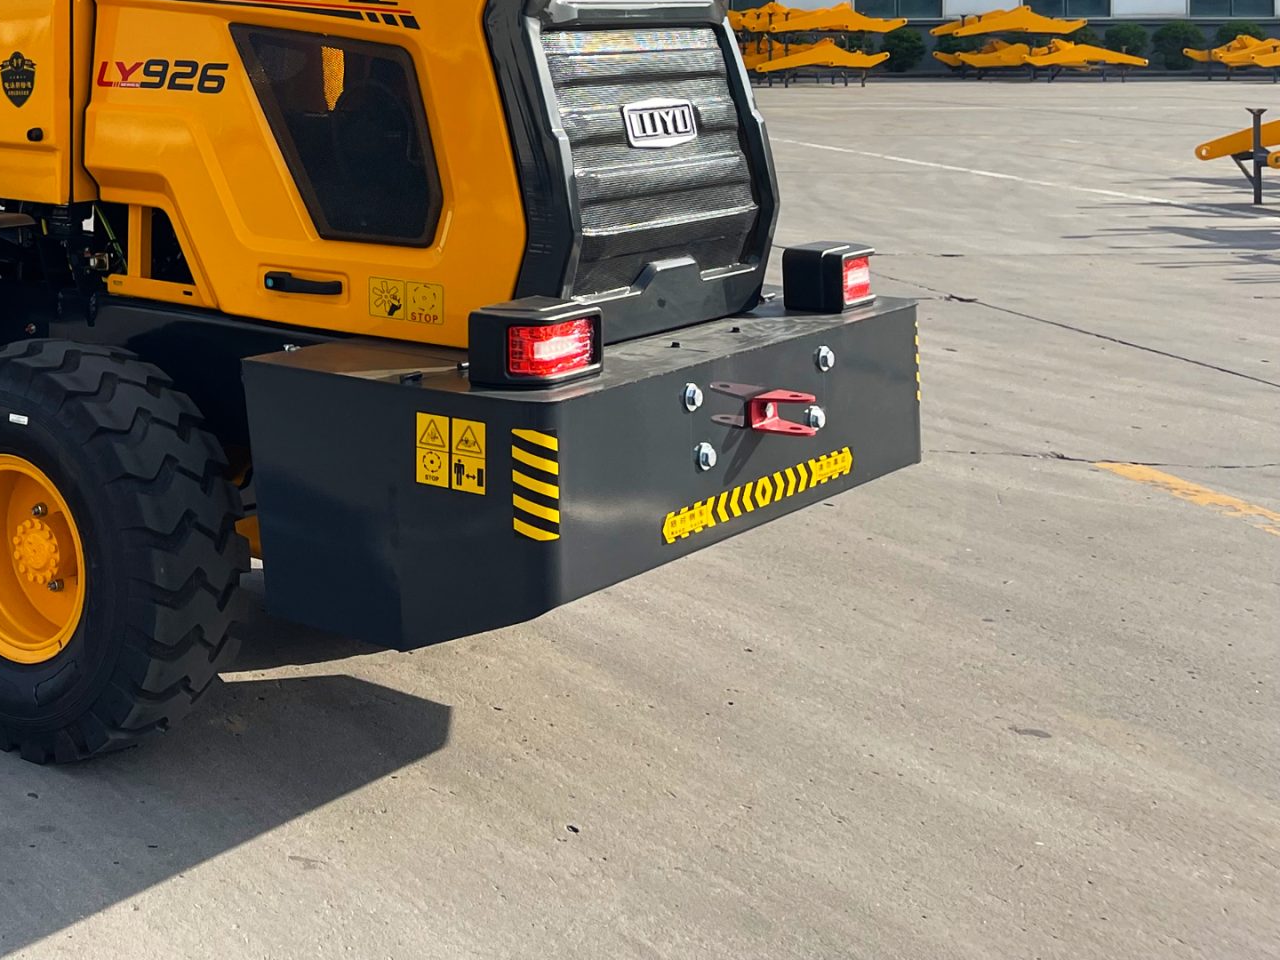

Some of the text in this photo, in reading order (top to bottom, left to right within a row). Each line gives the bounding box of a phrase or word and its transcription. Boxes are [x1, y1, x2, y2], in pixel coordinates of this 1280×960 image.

[96, 58, 229, 95] LY926
[629, 109, 692, 138] LUYU
[410, 311, 439, 325] STOP
[424, 474, 440, 482] STOP
